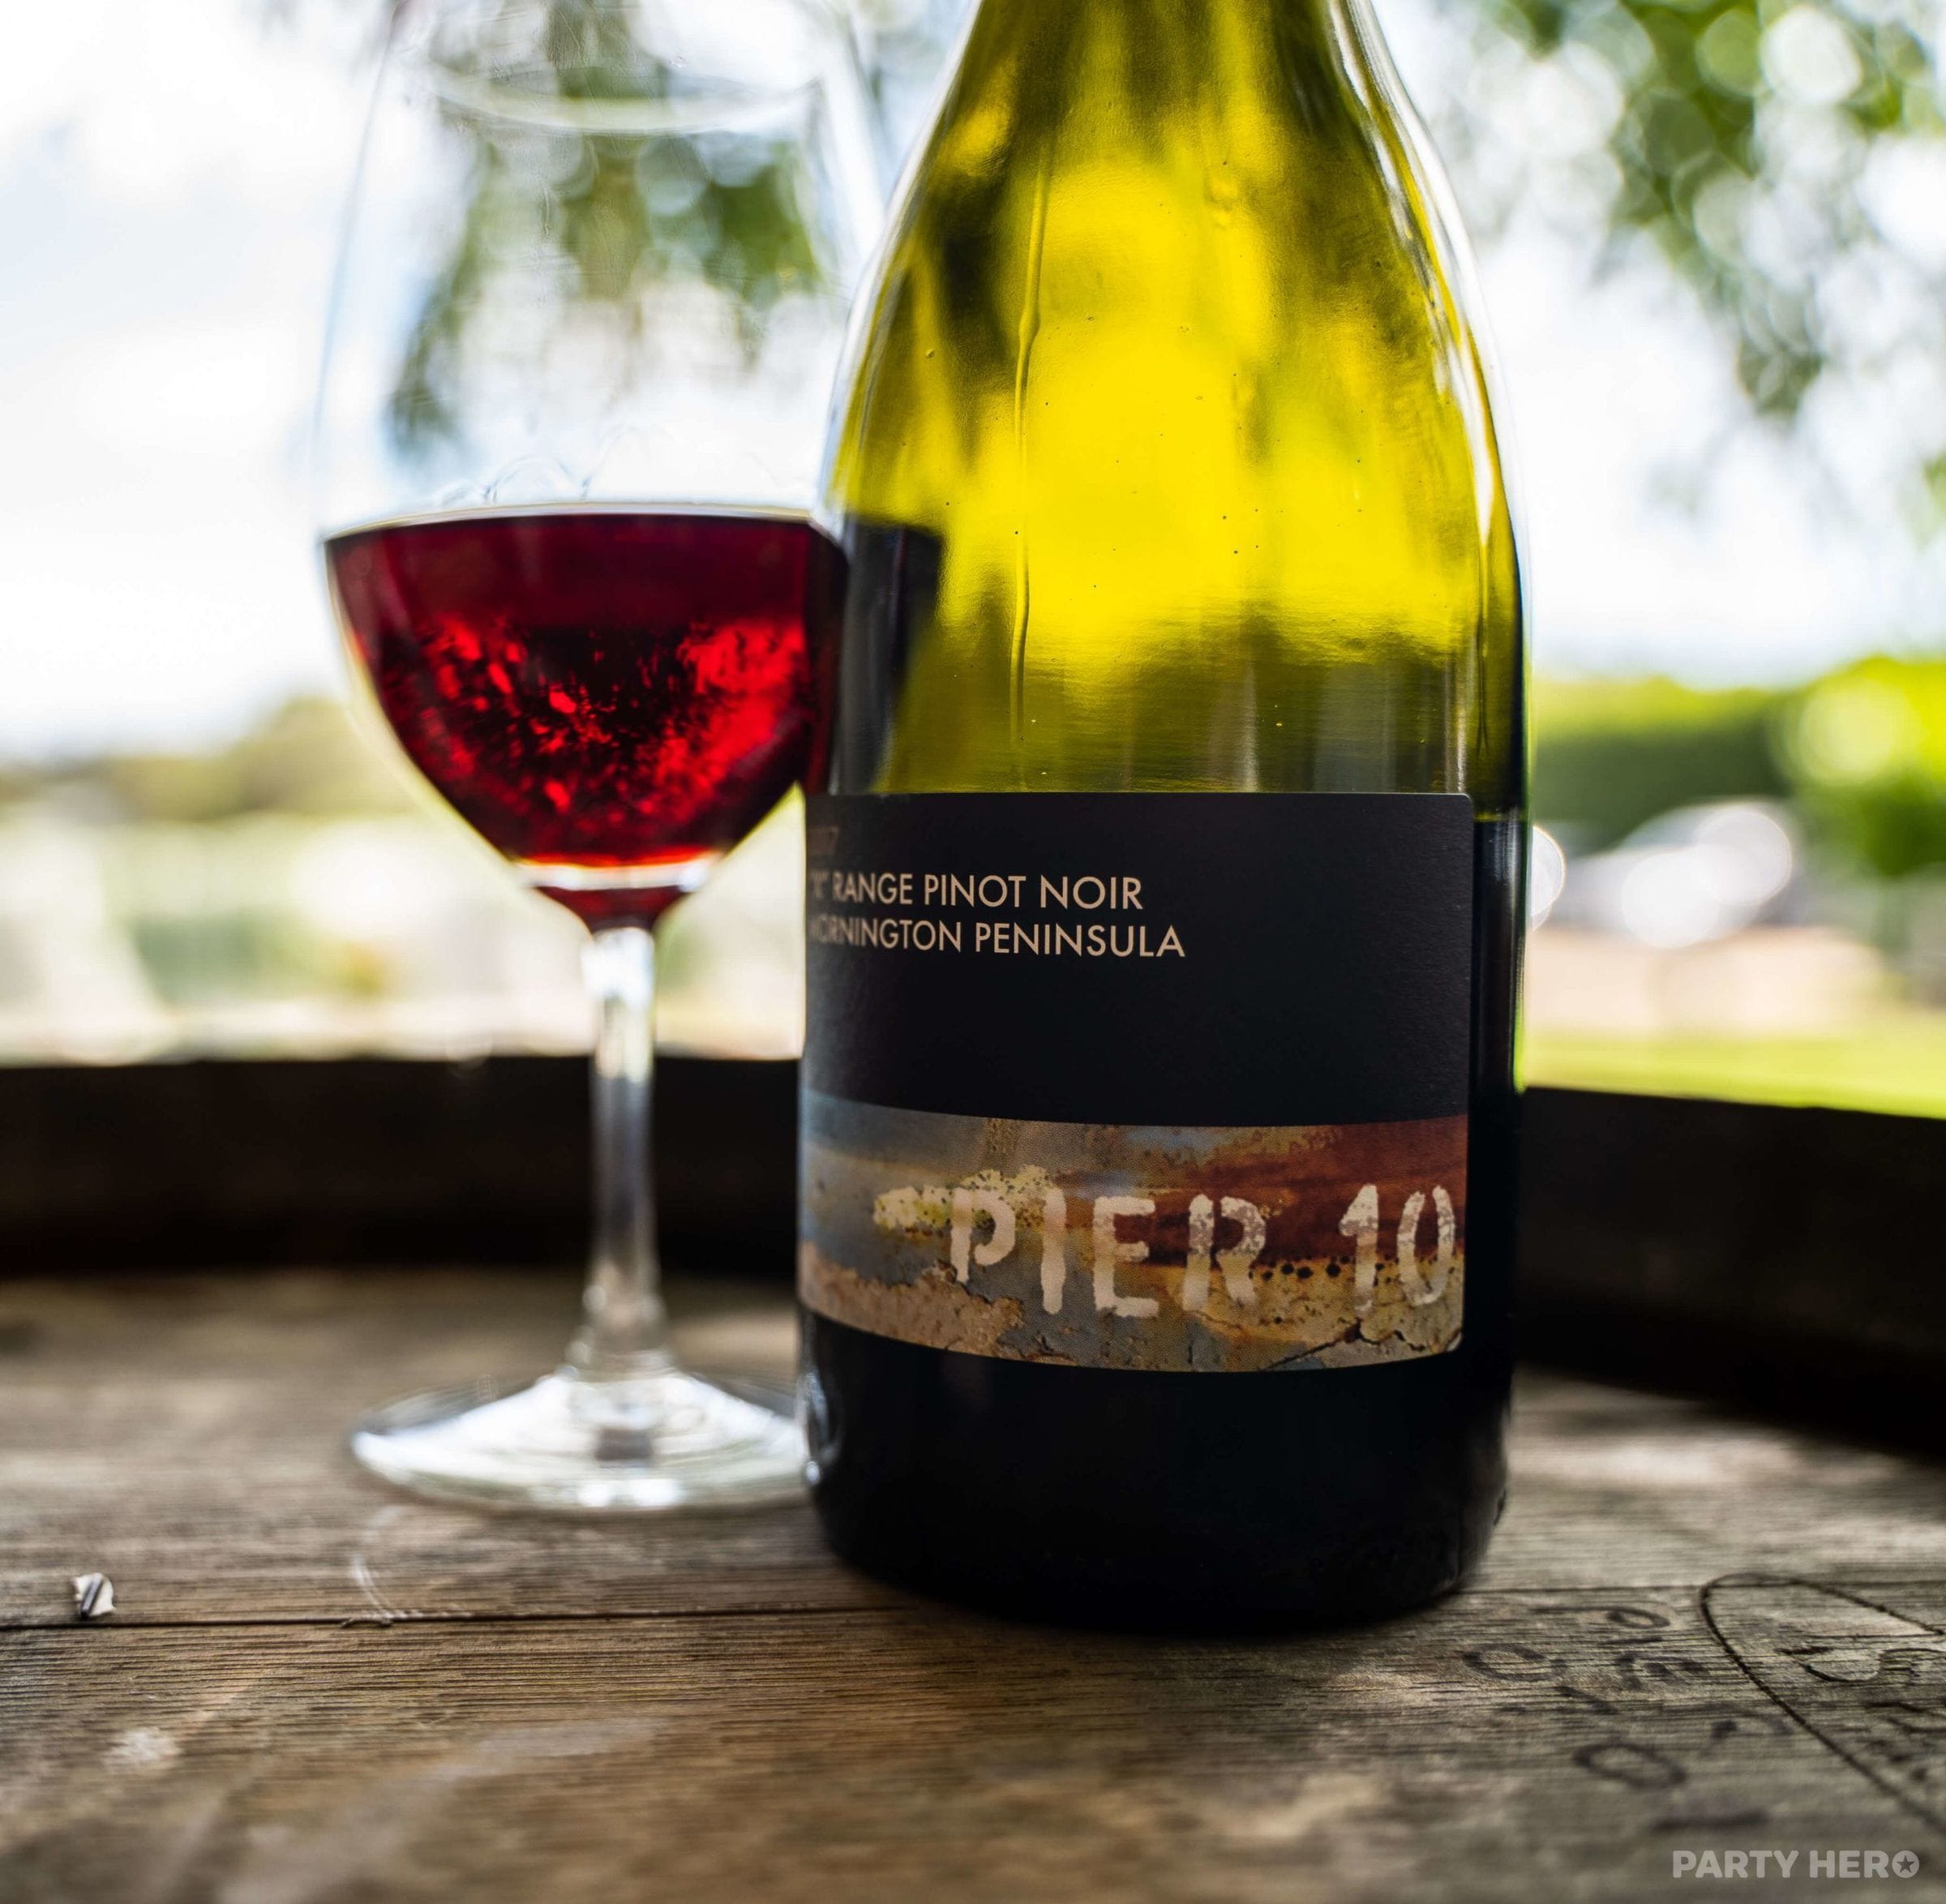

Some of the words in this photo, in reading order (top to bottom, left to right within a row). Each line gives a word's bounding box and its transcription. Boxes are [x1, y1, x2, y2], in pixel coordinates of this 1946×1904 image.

[832, 870, 913, 905] RANGE
[924, 874, 1027, 909] PINOT
[1040, 875, 1143, 910] NOIR
[975, 923, 1186, 958] PENINSULA
[950, 1186, 1267, 1318] PIER
[1339, 1184, 1456, 1317] 10
